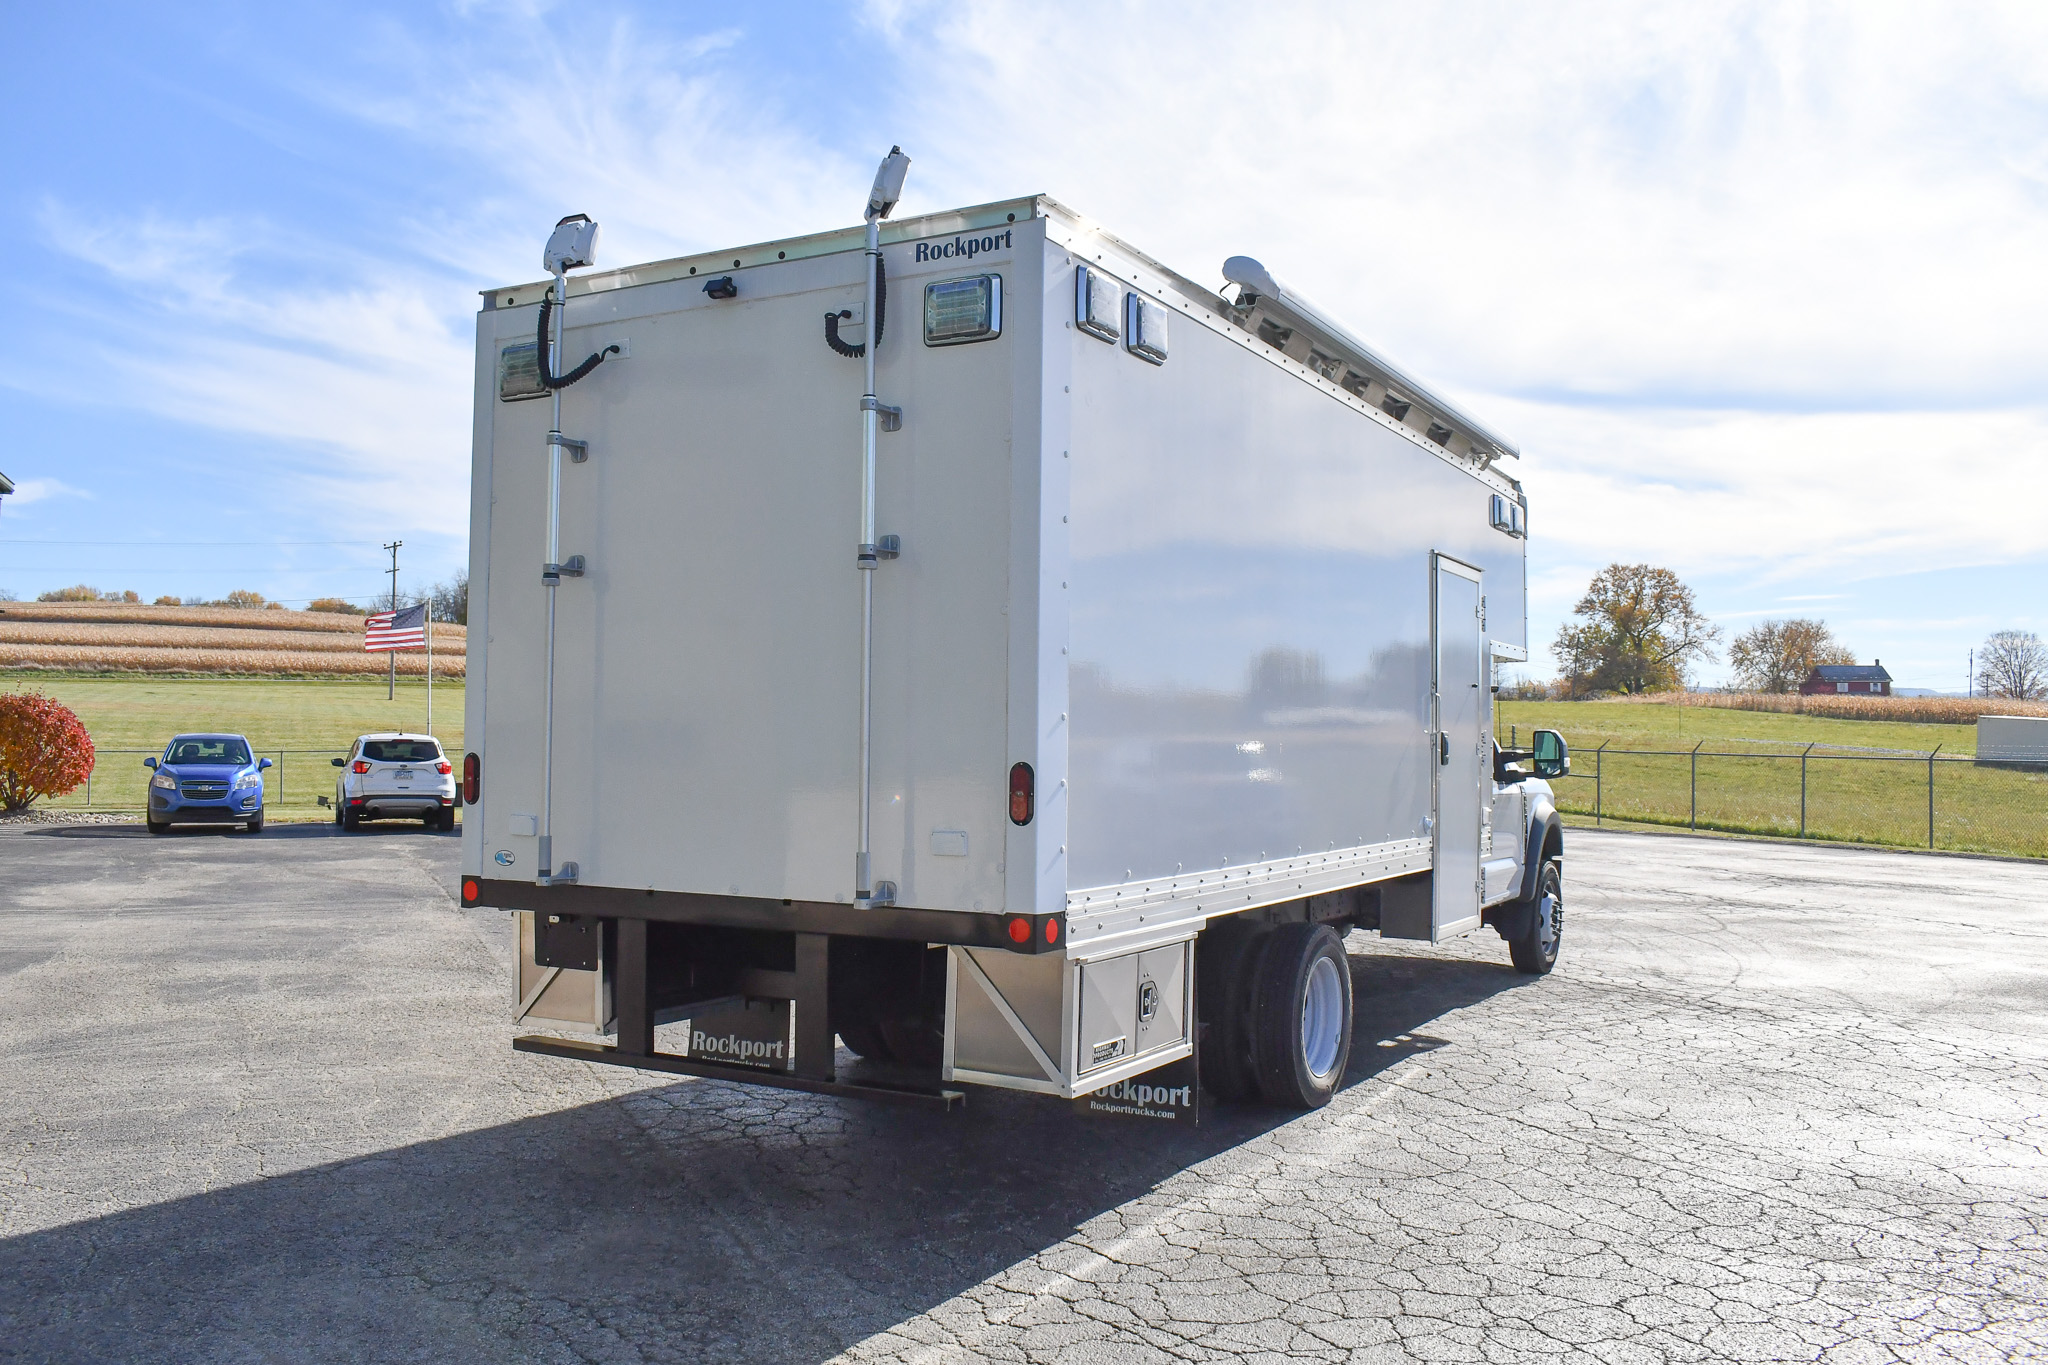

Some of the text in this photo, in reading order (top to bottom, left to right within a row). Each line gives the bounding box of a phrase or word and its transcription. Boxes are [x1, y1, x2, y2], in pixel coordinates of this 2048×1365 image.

[915, 229, 1013, 263] Rockport
[692, 1030, 784, 1060] Rockport
[1087, 1078, 1192, 1107] ockport
[1090, 1100, 1176, 1119] Rockporttrucks.com
